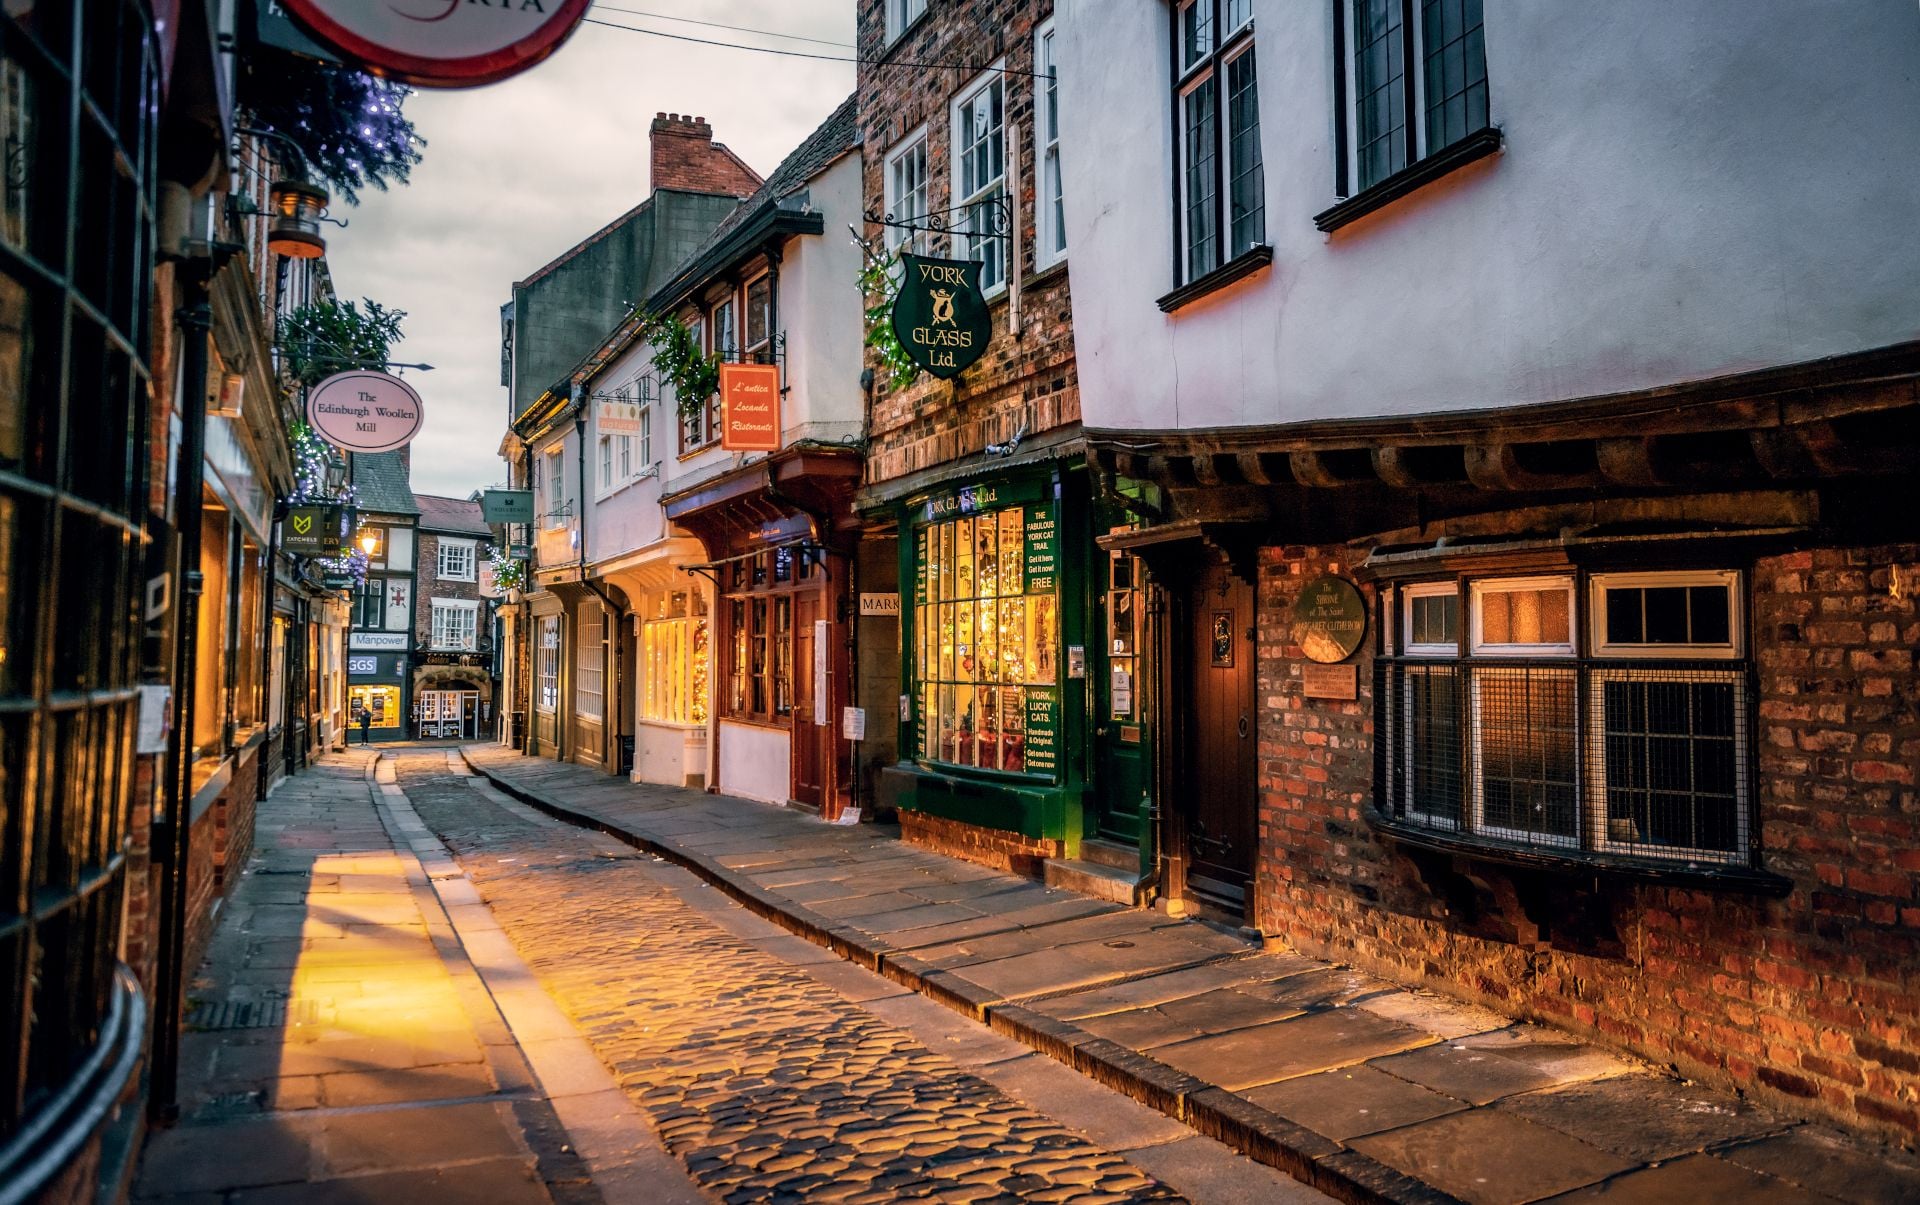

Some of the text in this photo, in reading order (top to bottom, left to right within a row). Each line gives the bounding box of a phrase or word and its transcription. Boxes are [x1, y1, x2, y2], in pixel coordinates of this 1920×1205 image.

[918, 264, 969, 288] YORK
[912, 326, 972, 347] GLASS
[929, 350, 957, 367] Ltd.
[358, 391, 376, 402] The
[318, 403, 415, 419] Edinburgh Woollen
[733, 401, 768, 412] Locanda
[355, 422, 376, 432] Mill
[731, 420, 773, 431] Ristorante
[1035, 511, 1046, 520] THE
[1027, 520, 1055, 531] FABULOUS
[1028, 531, 1054, 541] YORK CAT
[1033, 542, 1048, 551] TRAIL
[1028, 555, 1037, 563] Get
[1042, 554, 1053, 562] here
[1028, 566, 1037, 574] Get
[1031, 577, 1052, 588] FREE
[356, 634, 404, 646] Manpower
[1031, 691, 1050, 700] YORK
[1029, 702, 1052, 711] LUCKY
[1031, 713, 1050, 722] CATS.
[1028, 728, 1053, 737] Handmade
